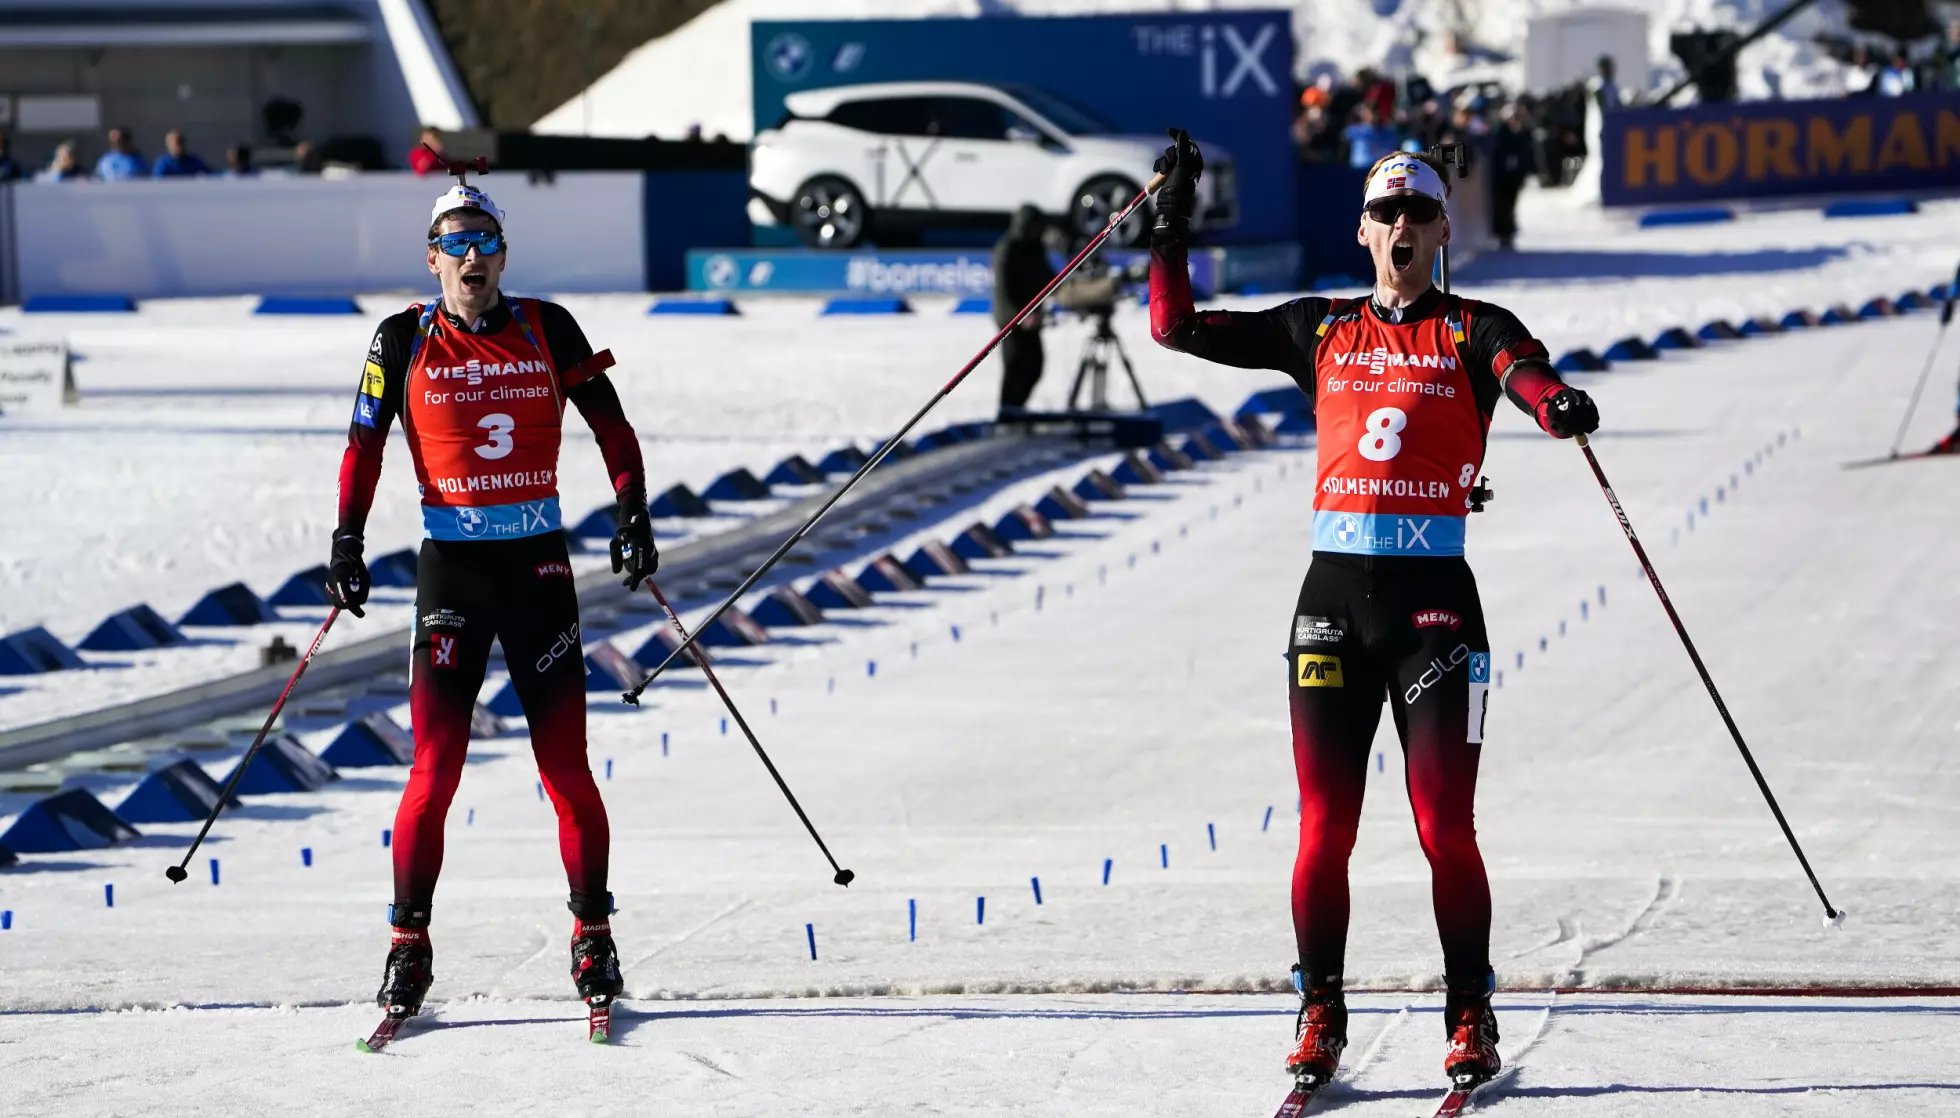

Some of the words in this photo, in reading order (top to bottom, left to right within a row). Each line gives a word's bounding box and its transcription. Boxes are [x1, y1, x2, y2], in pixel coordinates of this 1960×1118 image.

[1134, 24, 1196, 57] THE
[1201, 22, 1281, 99] iX
[425, 359, 551, 386] VIESSMANN
[1333, 347, 1457, 375] VIESSMANN
[424, 390, 450, 406] for
[454, 389, 486, 403] our
[490, 385, 549, 401] climate
[1327, 377, 1350, 393] for
[1352, 380, 1384, 393] our
[1387, 378, 1456, 398] climate
[473, 413, 515, 460] 3
[1358, 407, 1408, 462] 8
[1458, 463, 1475, 488] 8
[492, 522, 521, 537] THE
[520, 501, 550, 532] iX
[1363, 535, 1394, 550] THE
[1397, 518, 1432, 550] iX
[538, 564, 571, 577] MENY
[1416, 612, 1459, 627] MENY
[536, 622, 579, 673] odlo
[1404, 643, 1470, 705] odlo
